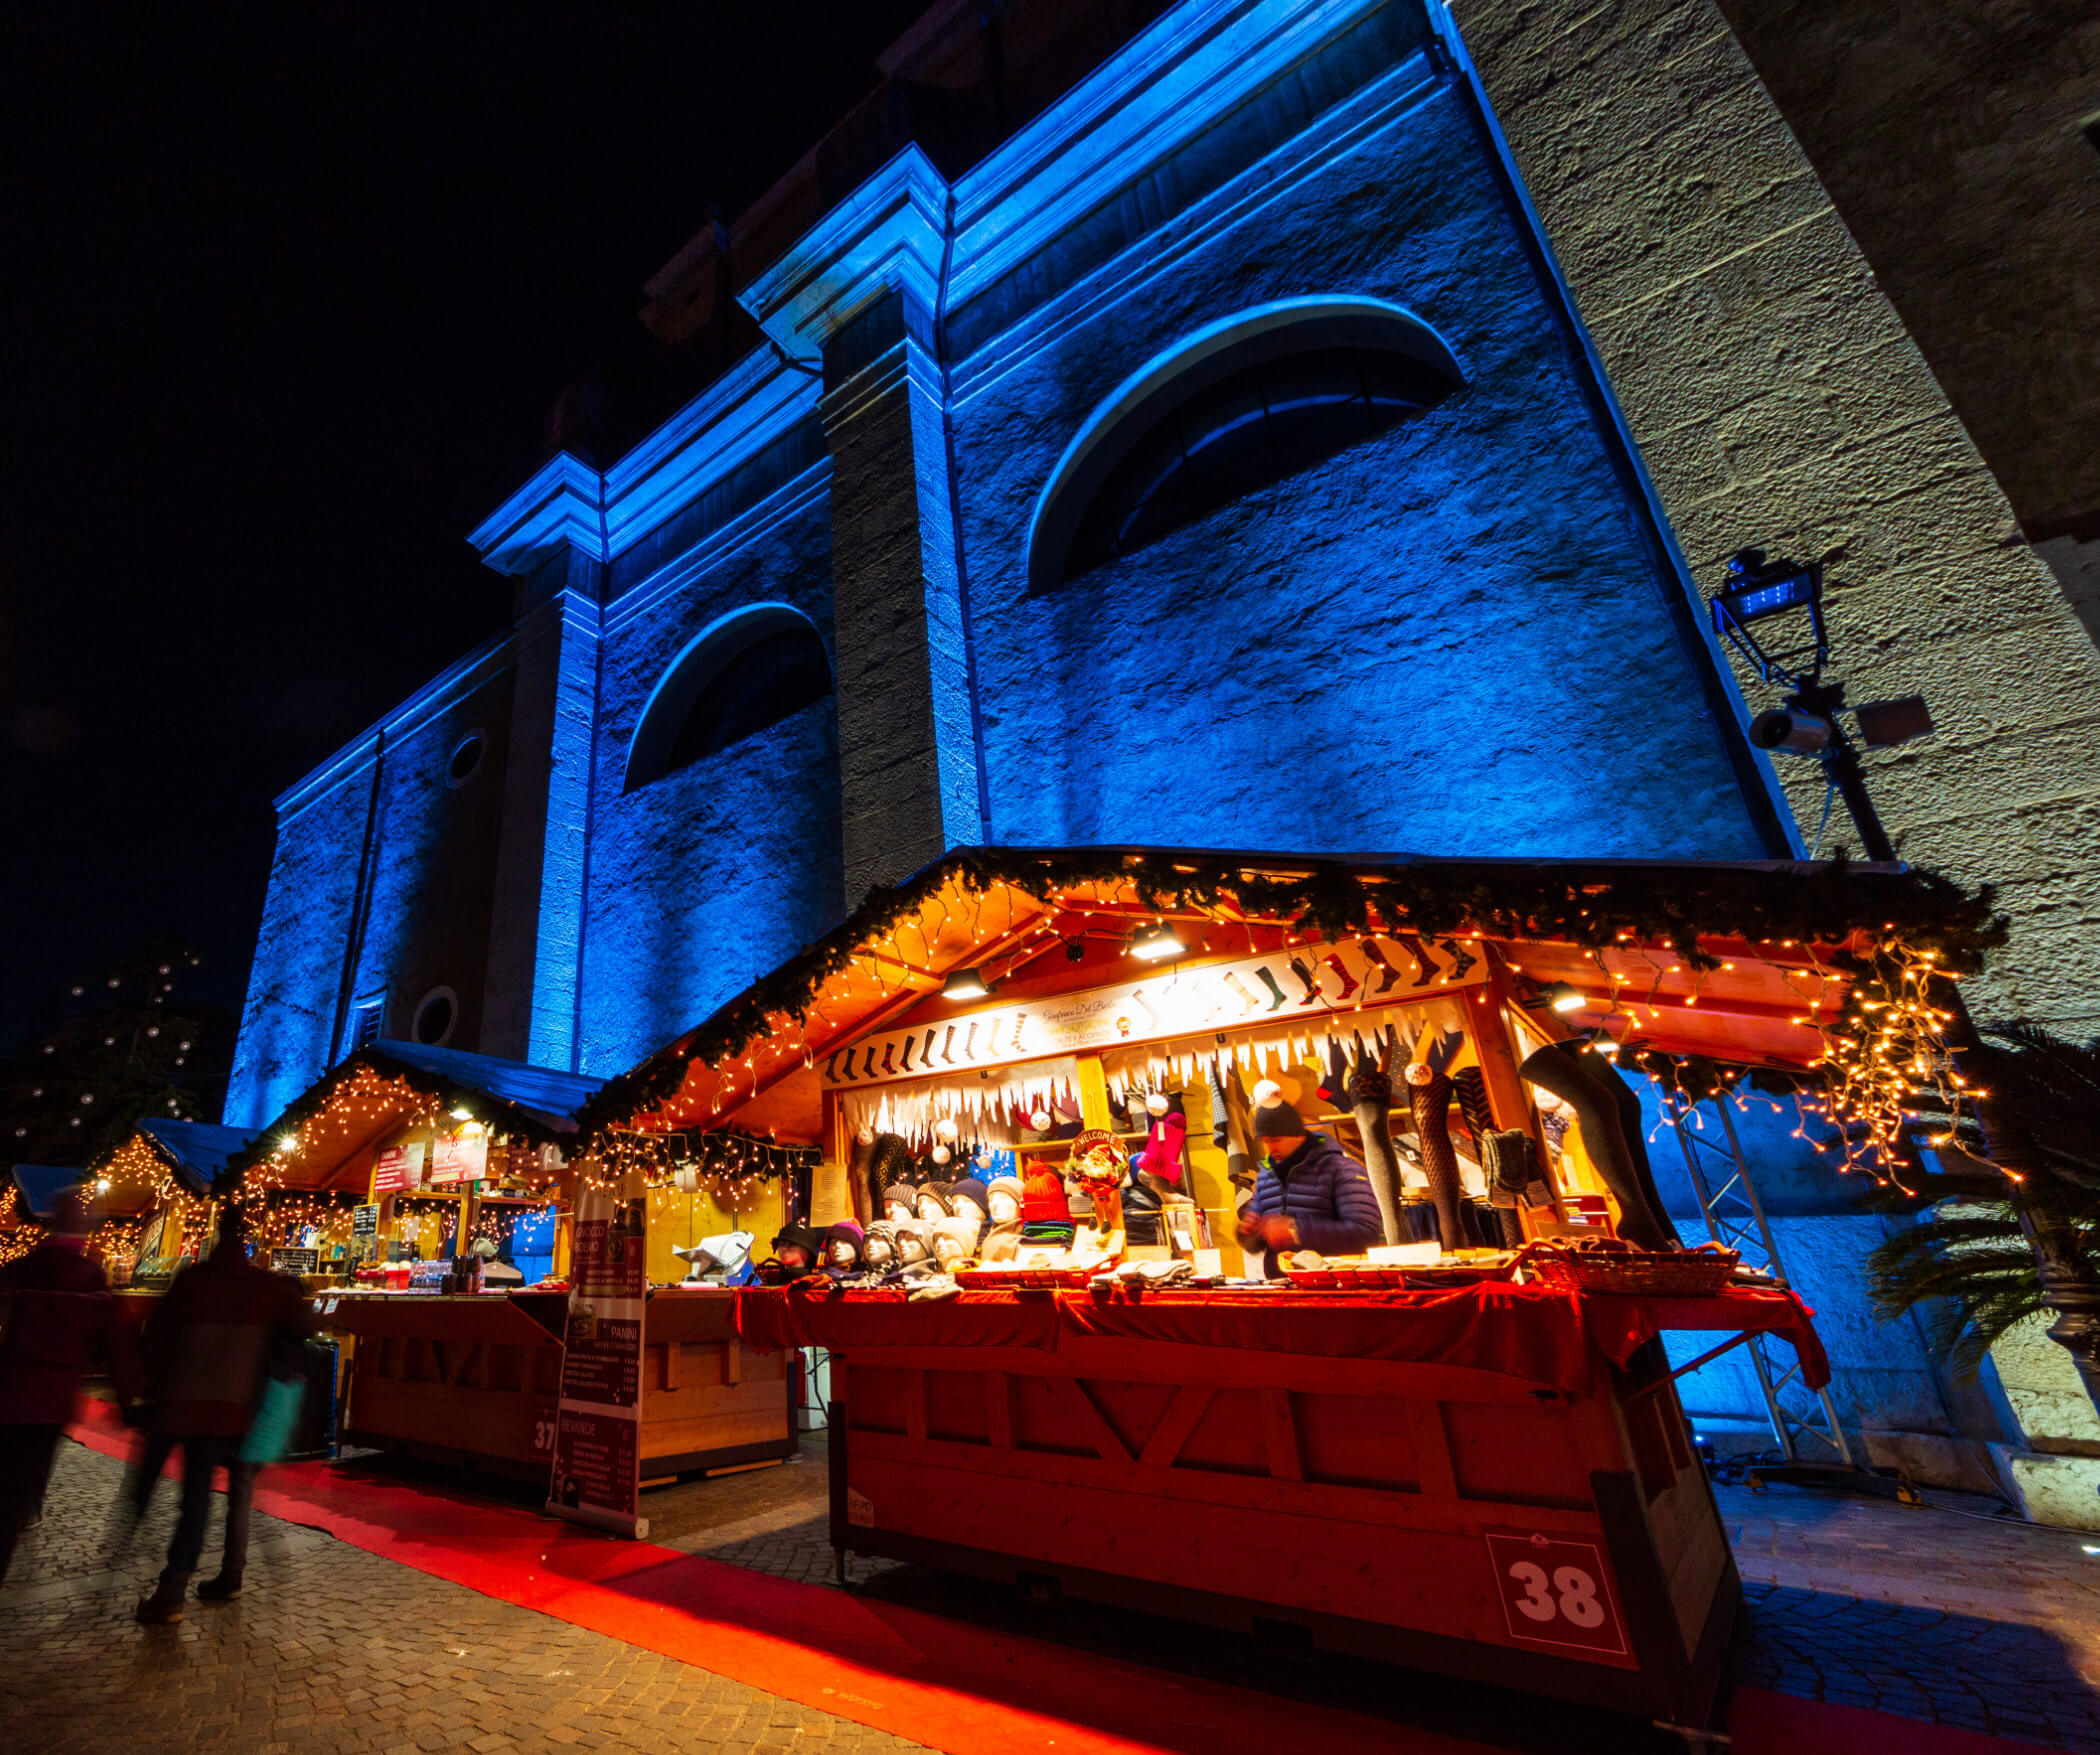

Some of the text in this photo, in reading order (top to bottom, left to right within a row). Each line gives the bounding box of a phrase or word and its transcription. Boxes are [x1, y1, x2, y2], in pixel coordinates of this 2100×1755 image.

[1078, 1131, 1115, 1146] WELCOME
[610, 1326, 638, 1341] PANINI
[534, 1420, 556, 1451] 37
[560, 1415, 597, 1438] BEVANDE
[1508, 1560, 1606, 1629] 38
